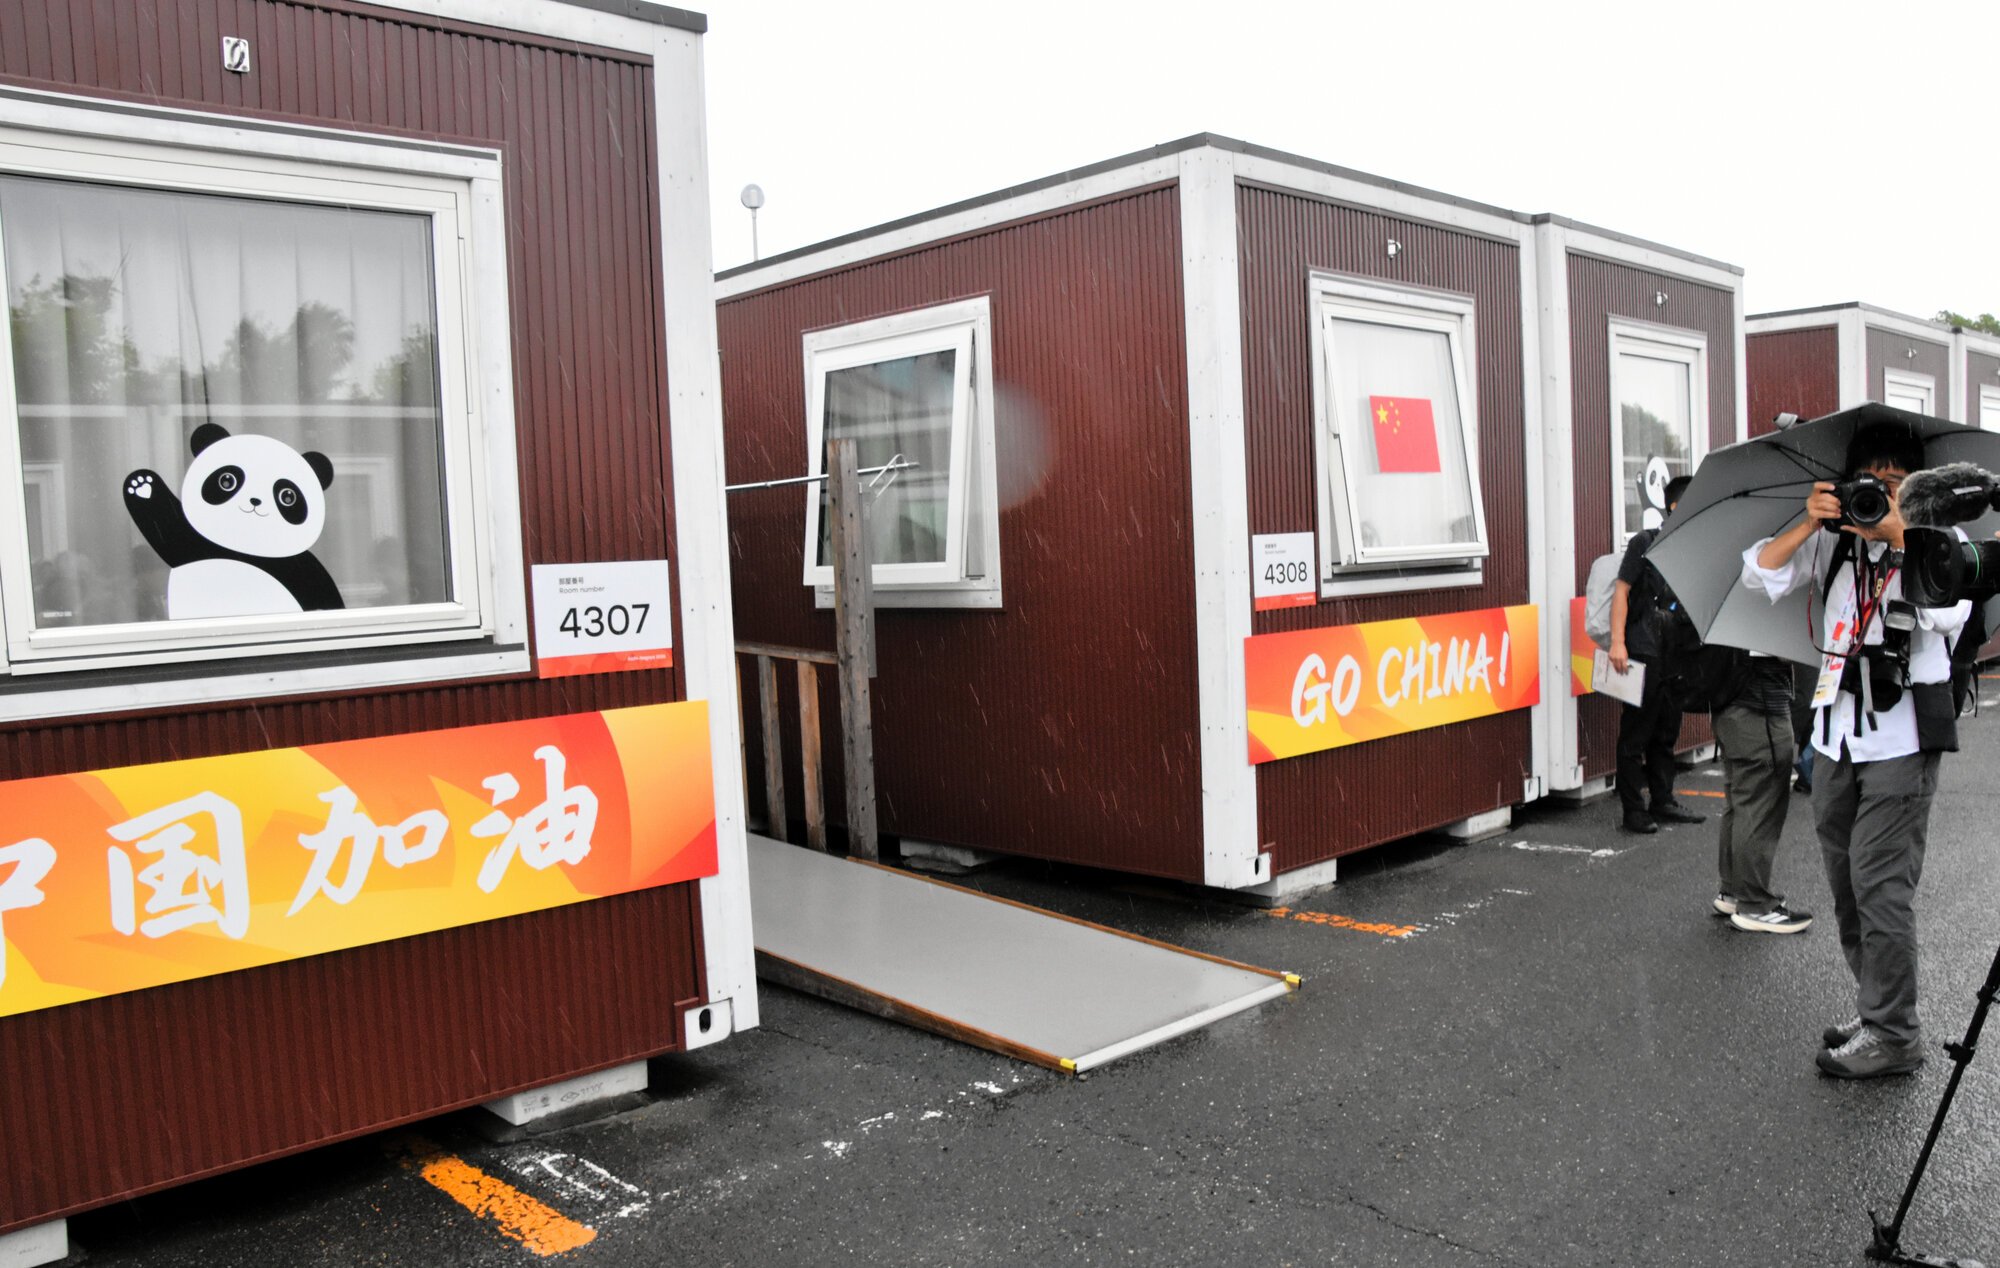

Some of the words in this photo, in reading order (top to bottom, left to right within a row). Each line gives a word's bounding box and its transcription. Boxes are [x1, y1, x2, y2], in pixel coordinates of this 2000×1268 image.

[1264, 561, 1308, 585] 4308
[560, 603, 650, 638] 4307
[1291, 653, 1361, 727] GO
[1377, 631, 1509, 708] CHINA!
